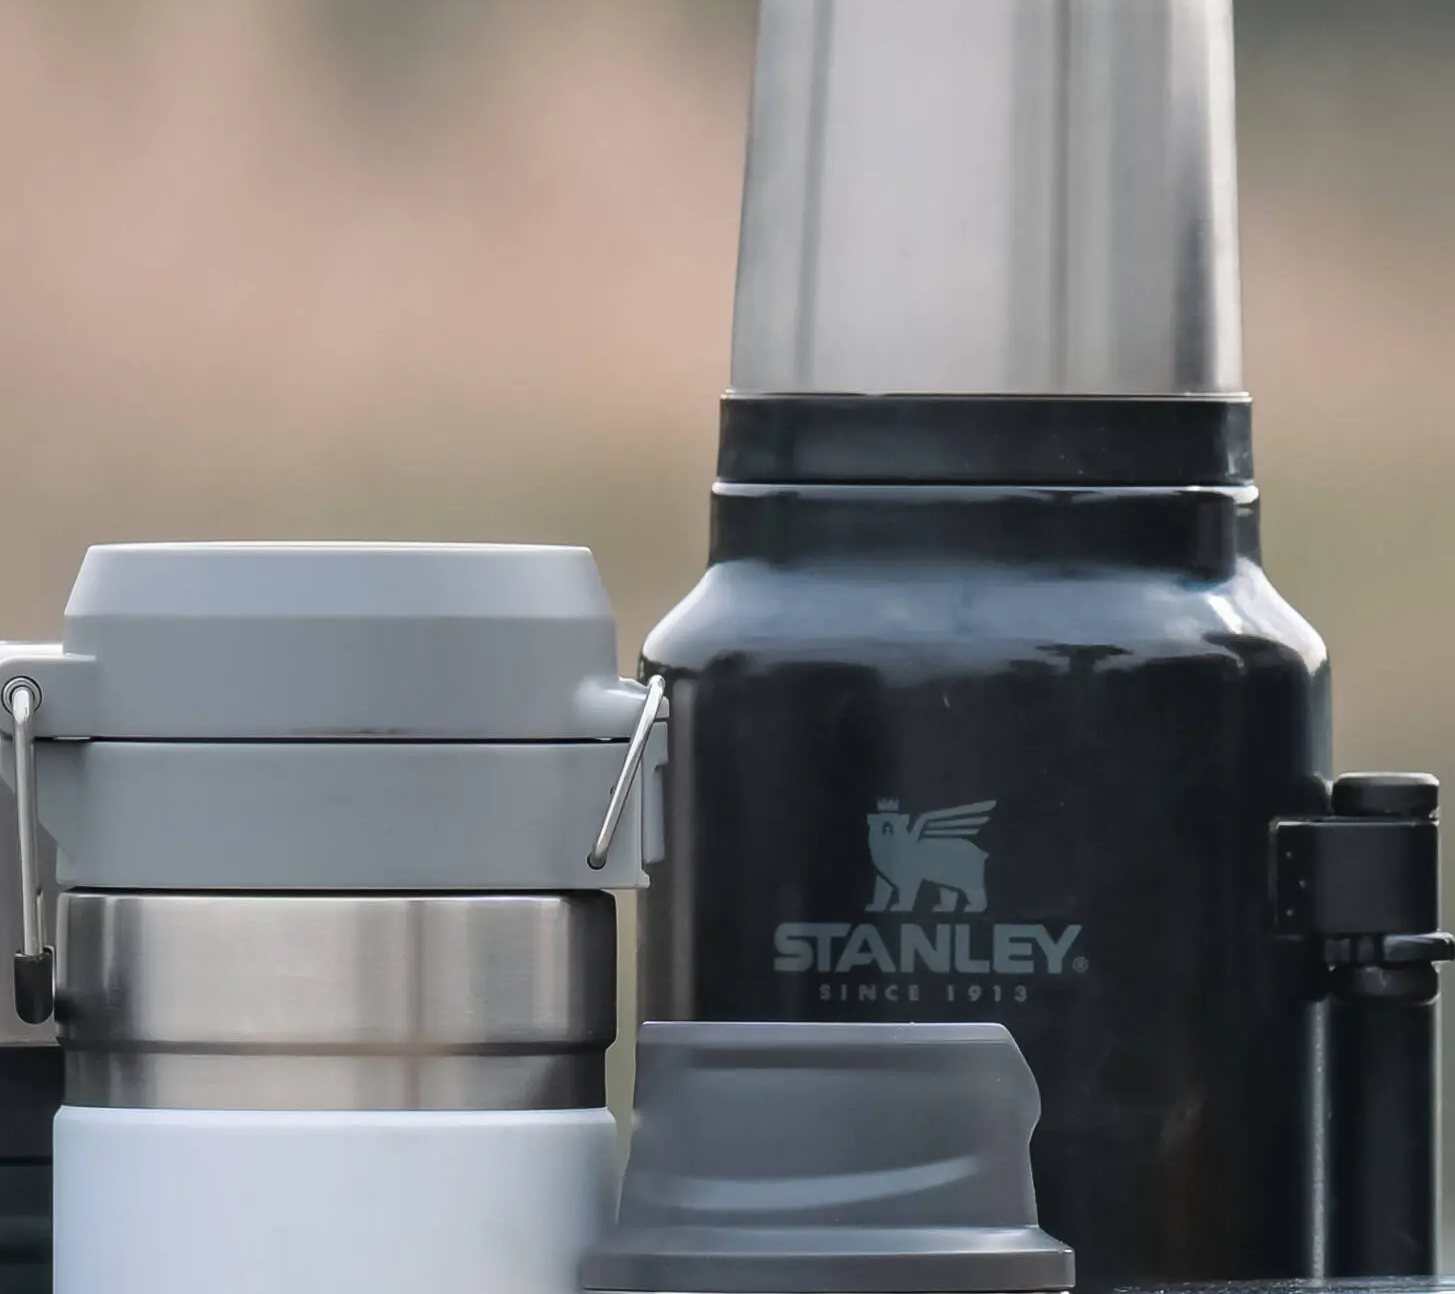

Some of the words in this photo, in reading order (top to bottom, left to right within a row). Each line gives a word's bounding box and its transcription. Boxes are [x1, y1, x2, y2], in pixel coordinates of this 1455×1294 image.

[773, 922, 1083, 974] STANLEY
[818, 983, 920, 1003] SINCE
[947, 983, 1029, 1003] 1913
